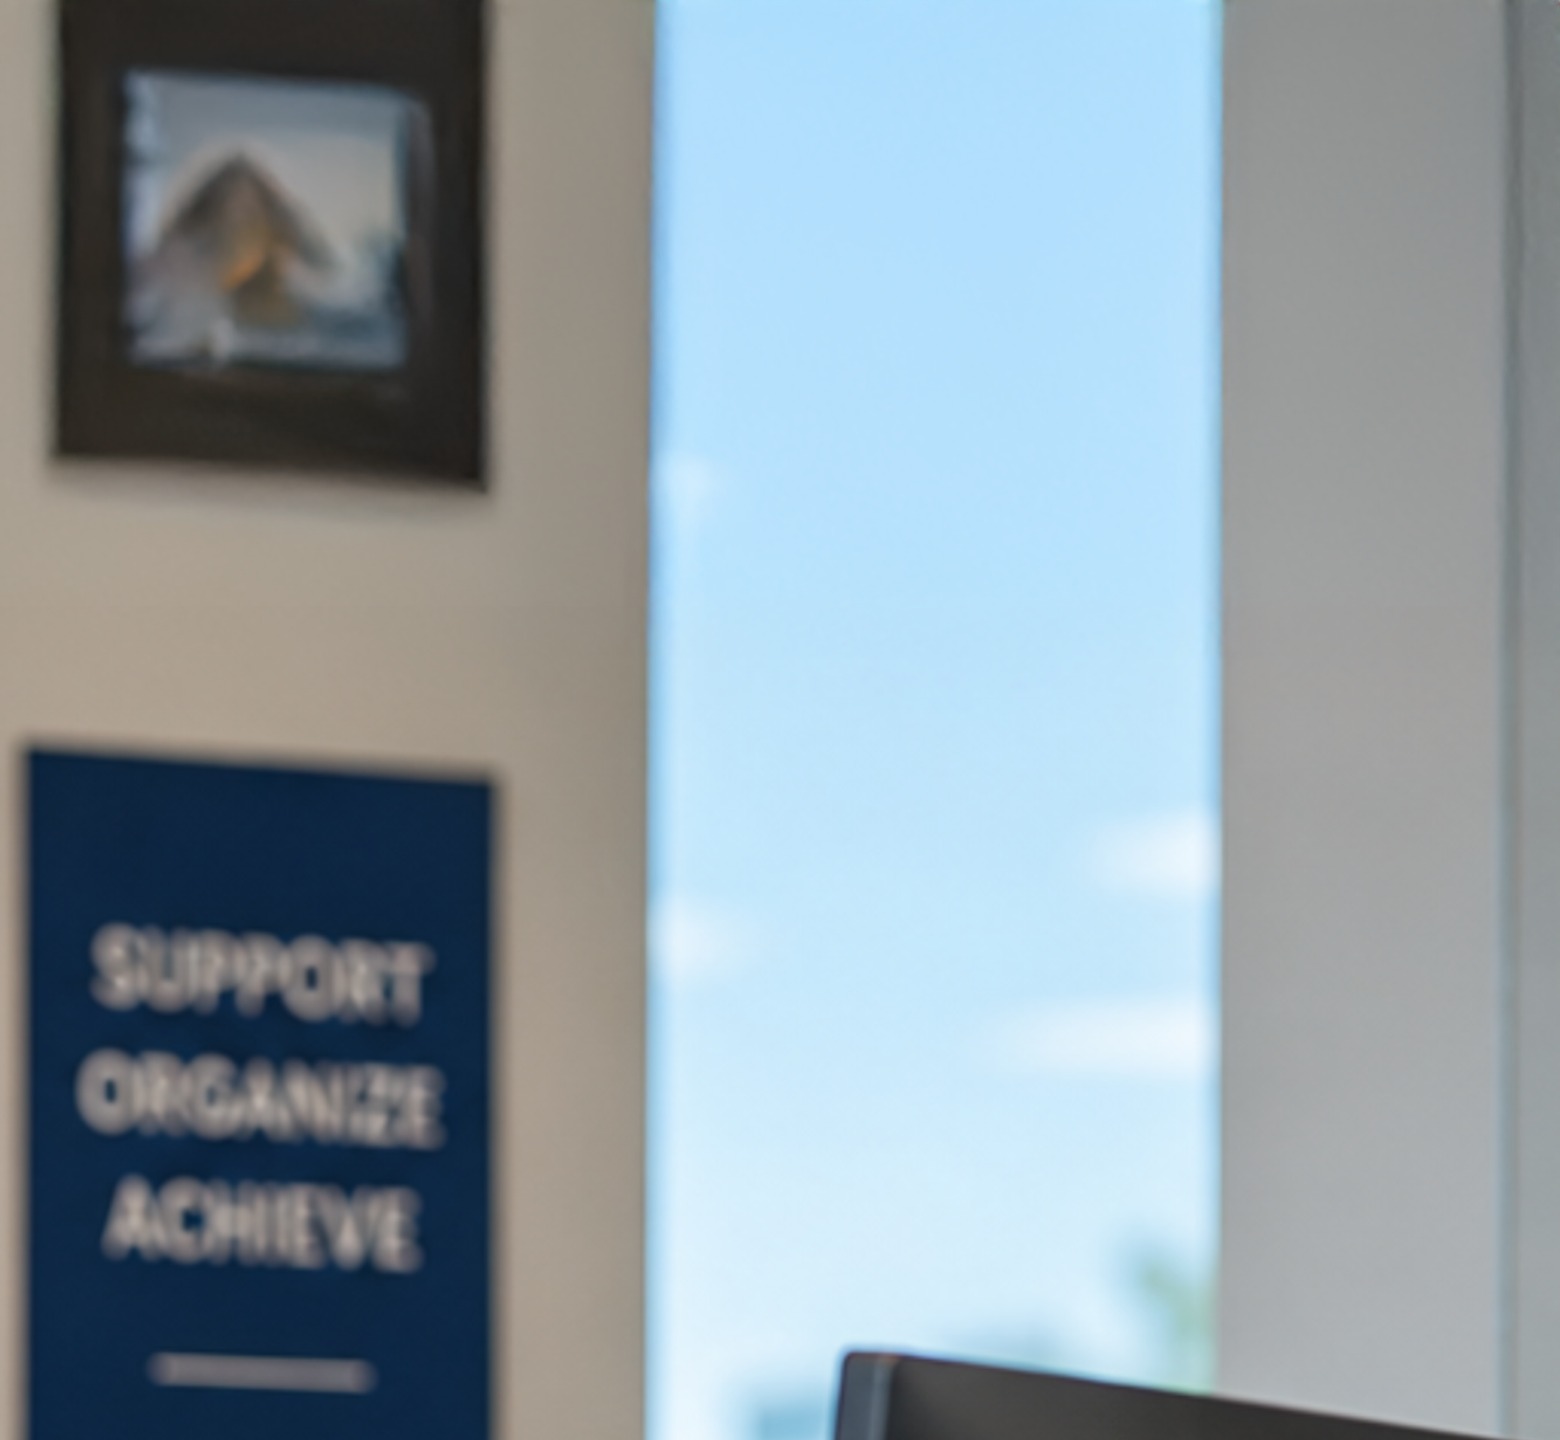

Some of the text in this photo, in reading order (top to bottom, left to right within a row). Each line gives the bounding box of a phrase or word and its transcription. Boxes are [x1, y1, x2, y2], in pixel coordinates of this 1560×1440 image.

[92, 924, 432, 1022] SUPPORT
[77, 1050, 442, 1147] ORGANIZE
[103, 1177, 419, 1271] ACHIEVE
